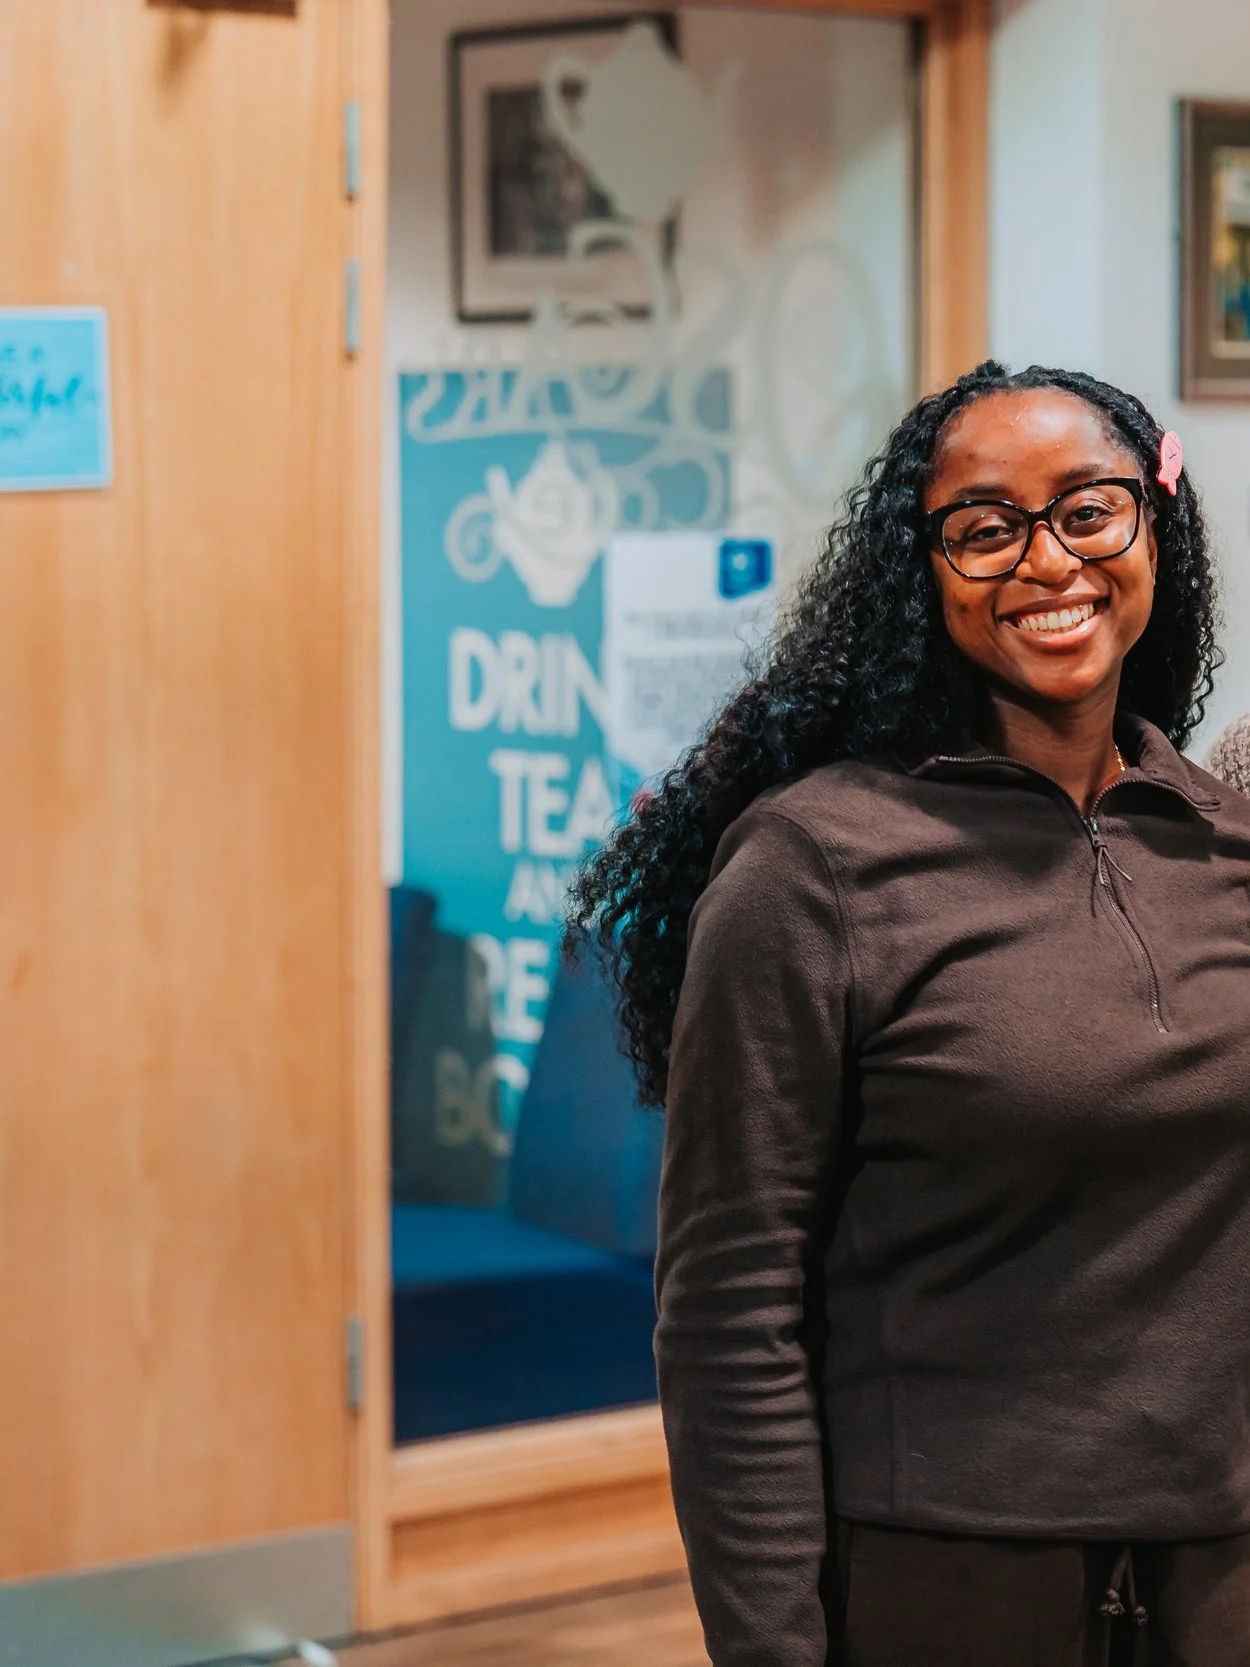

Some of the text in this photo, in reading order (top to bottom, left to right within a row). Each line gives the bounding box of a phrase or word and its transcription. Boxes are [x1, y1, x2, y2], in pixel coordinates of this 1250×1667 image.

[448, 625, 612, 739] DRIN
[488, 747, 615, 858] TEA
[502, 860, 567, 925] AN
[464, 932, 551, 1045] RE
